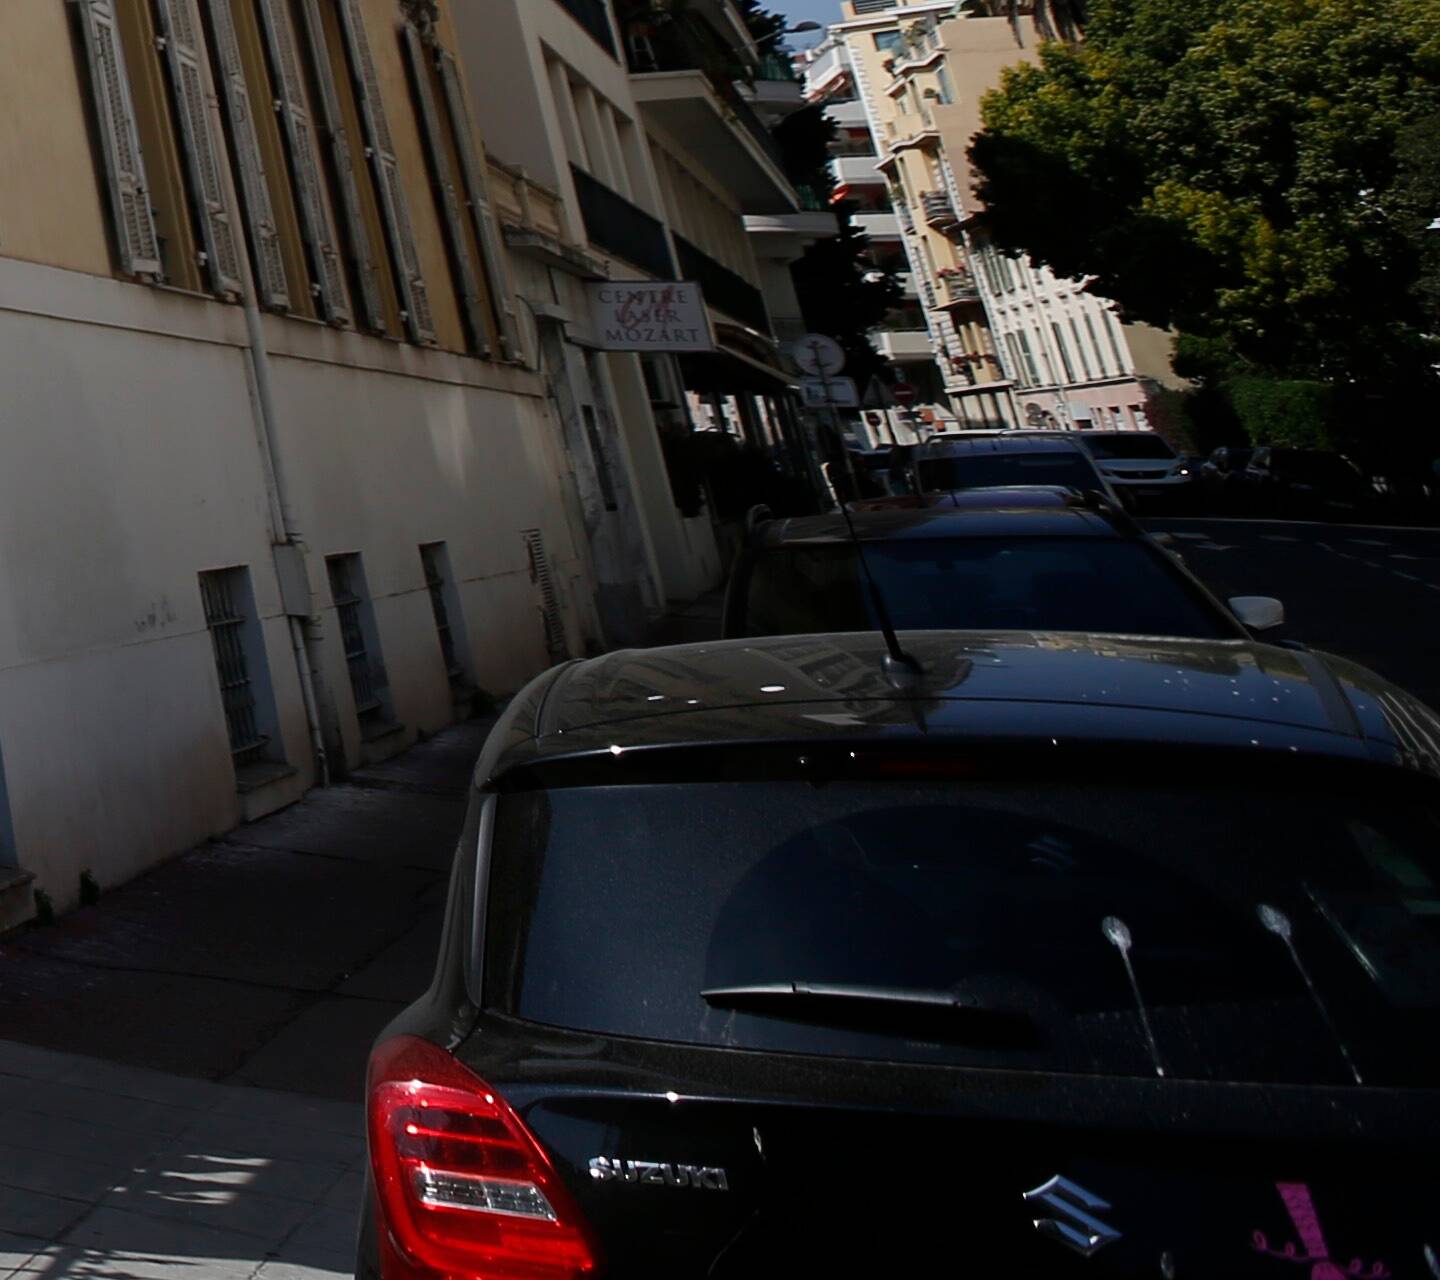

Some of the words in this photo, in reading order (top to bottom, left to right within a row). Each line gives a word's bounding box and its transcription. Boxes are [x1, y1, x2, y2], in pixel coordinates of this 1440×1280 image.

[598, 290, 688, 304] CENTRE
[606, 328, 699, 342] MOZART
[588, 1155, 729, 1191] SUZUKI
